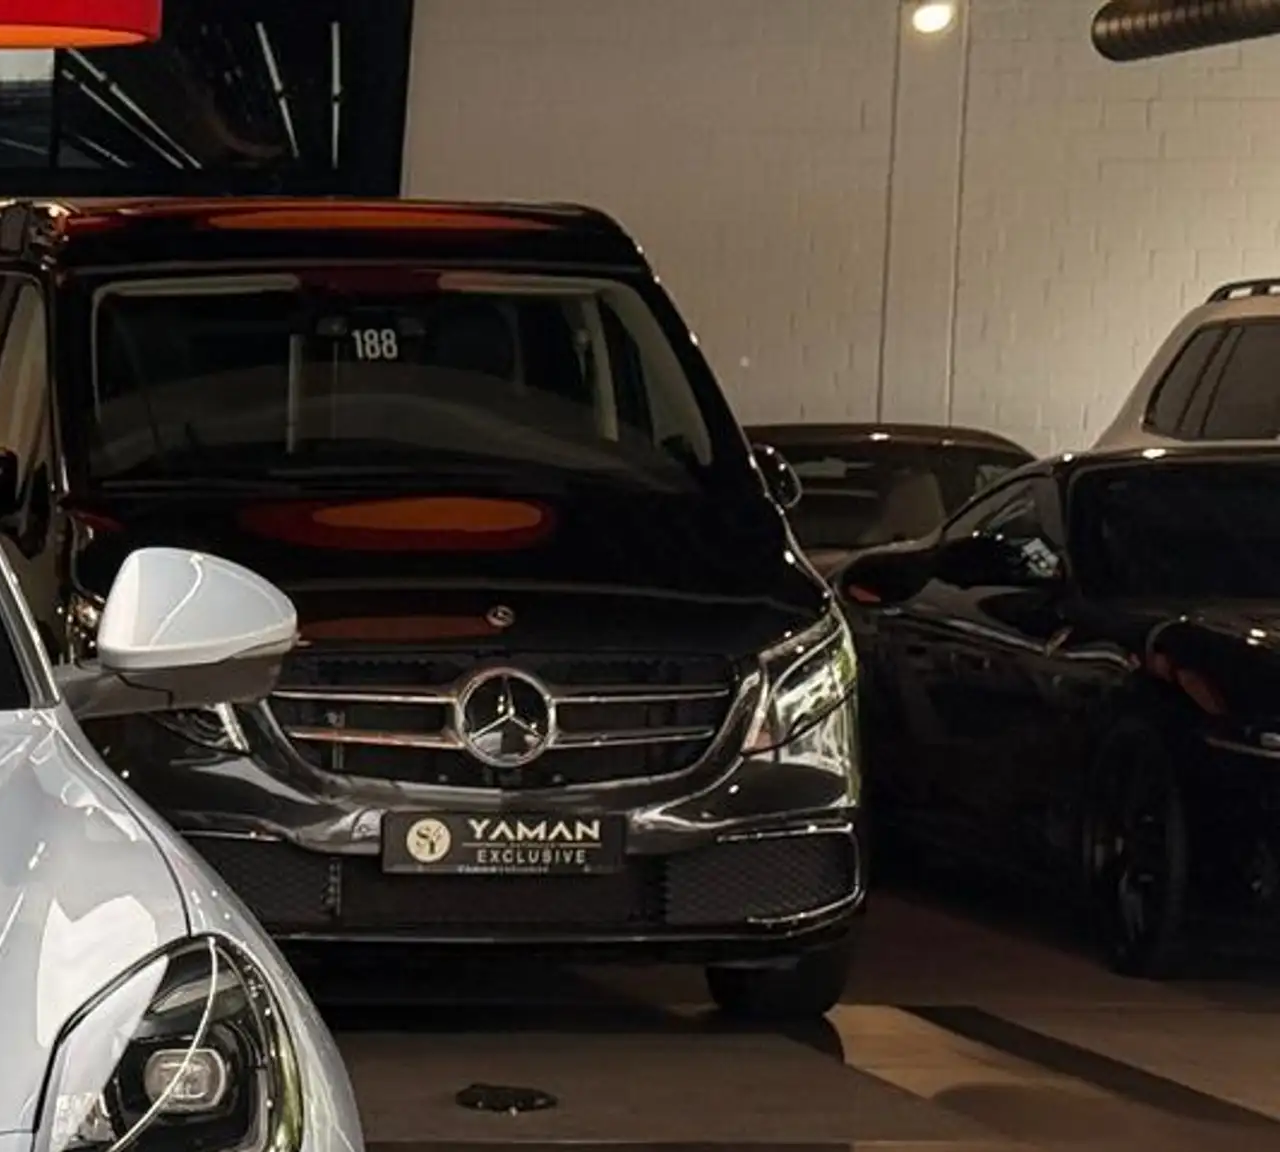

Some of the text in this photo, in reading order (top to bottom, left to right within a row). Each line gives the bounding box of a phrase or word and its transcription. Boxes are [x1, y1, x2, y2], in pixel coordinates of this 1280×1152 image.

[351, 328, 398, 360] 188
[468, 819, 600, 841] YAMAN
[477, 849, 586, 864] EXCLUSIVE
